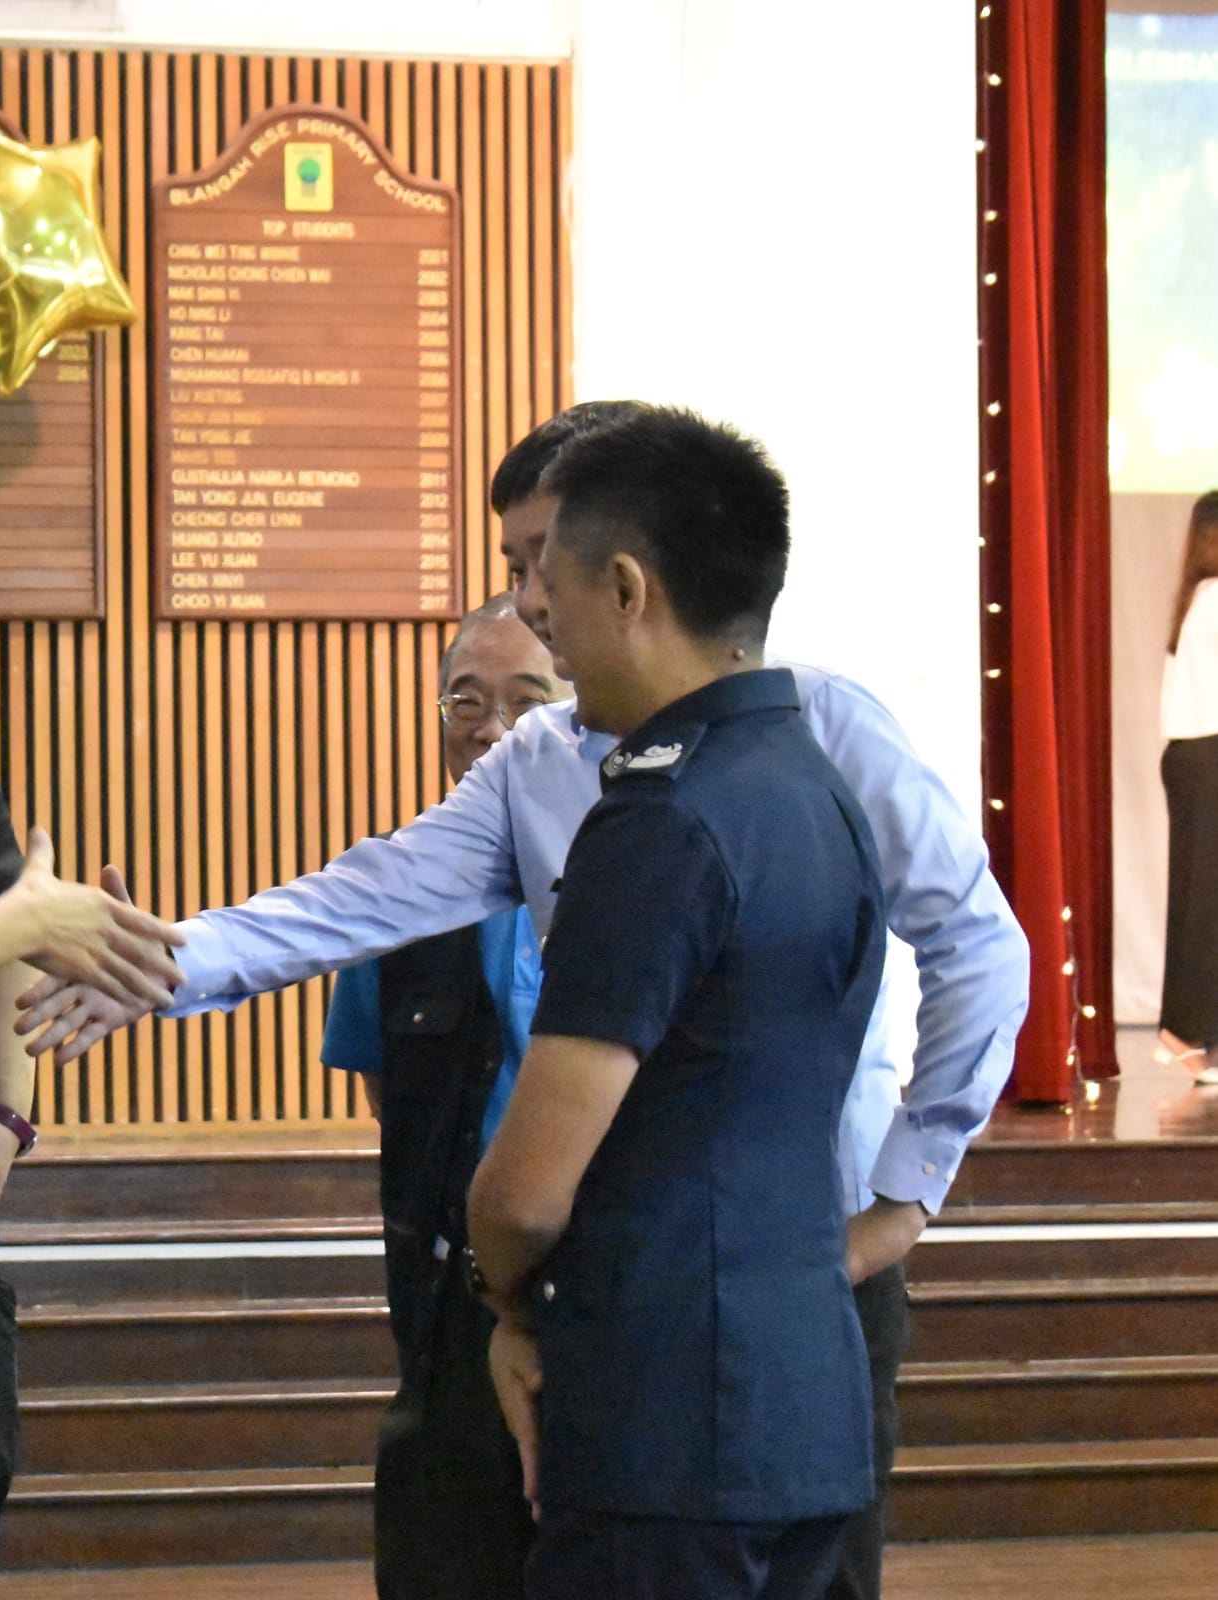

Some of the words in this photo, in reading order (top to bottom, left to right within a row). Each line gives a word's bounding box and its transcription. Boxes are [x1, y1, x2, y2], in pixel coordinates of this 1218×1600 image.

[170, 158, 253, 206] BLANGAH
[250, 122, 291, 157] RISE
[297, 119, 377, 166] PRIMARY
[374, 170, 447, 213] SCHOOL
[262, 222, 286, 236] TOP
[292, 222, 355, 238] STUDENTS
[172, 490, 196, 505] TAN
[201, 491, 236, 505] YONG
[273, 492, 325, 507] EUGENE
[420, 493, 448, 508] 2012
[172, 511, 227, 526] CHEONG
[172, 532, 219, 547] HUANG
[420, 534, 449, 548] 2014
[172, 553, 197, 568] LEE
[200, 553, 219, 568] YU
[222, 553, 257, 568] XUAN
[420, 554, 449, 569] 2015
[172, 574, 208, 588] CHEN
[172, 594, 211, 609] CHOO
[214, 595, 226, 609] YI
[230, 596, 265, 609] XUAN
[420, 595, 449, 610] 2017
